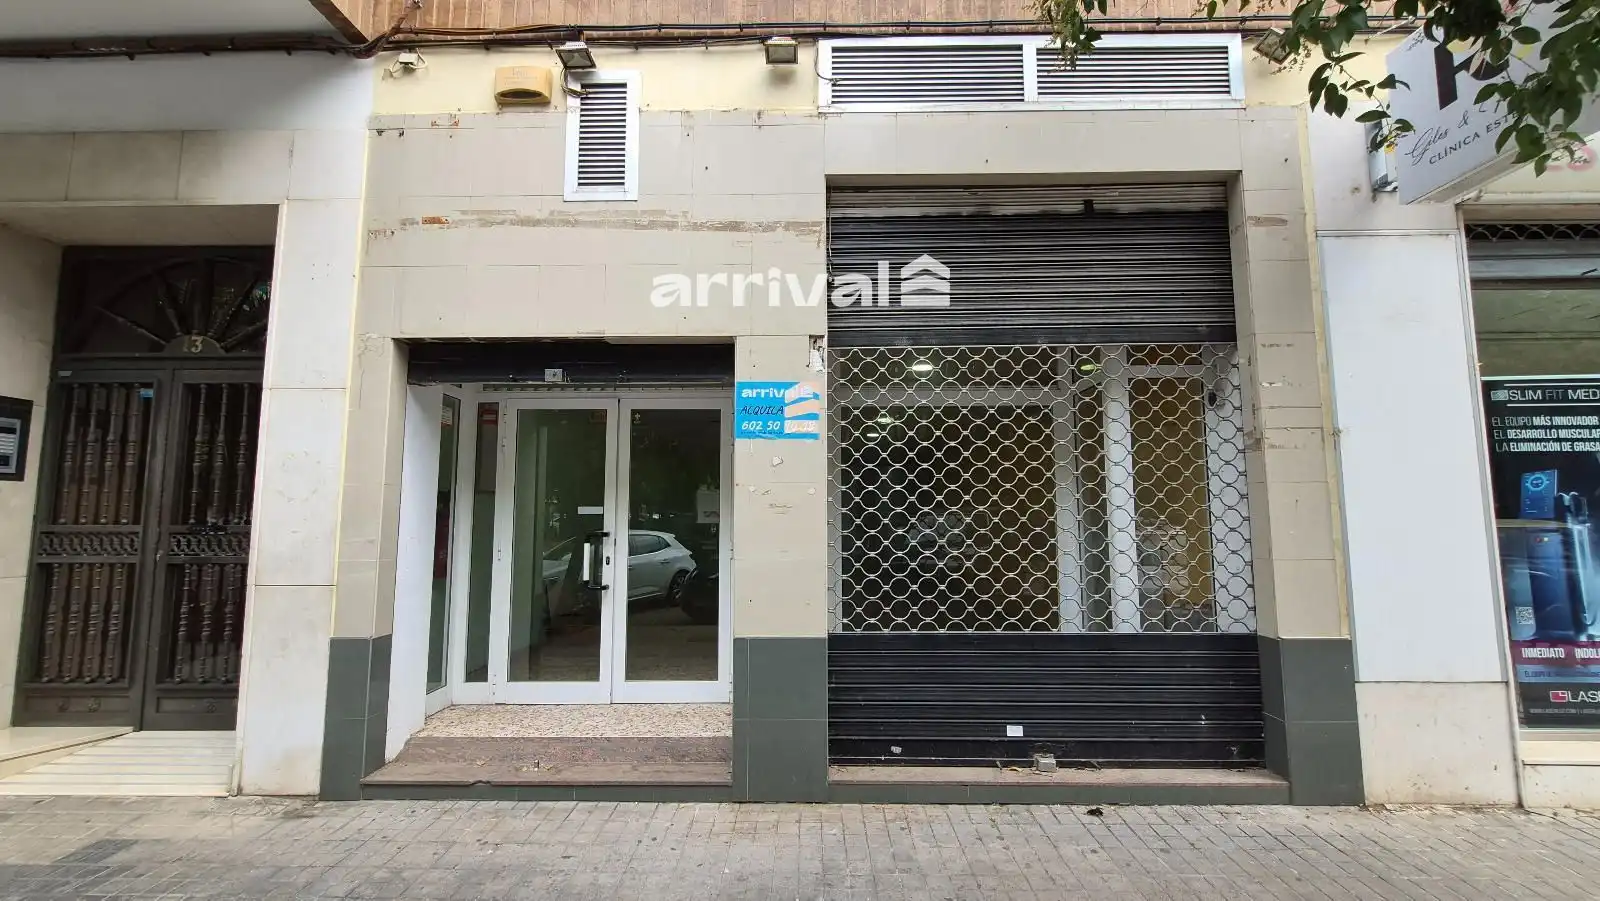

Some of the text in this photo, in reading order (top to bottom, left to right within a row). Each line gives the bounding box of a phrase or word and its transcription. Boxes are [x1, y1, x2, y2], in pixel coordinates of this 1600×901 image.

[1457, 110, 1469, 128] &
[741, 387, 803, 399] arrivl
[1509, 389, 1542, 401] SLIM
[1545, 389, 1564, 400] FIT
[741, 420, 763, 431] 602
[1492, 416, 1504, 427] EL
[1505, 416, 1531, 426] EQUIPO
[1532, 414, 1551, 426] MÁS
[1494, 429, 1505, 440] EL
[1507, 429, 1557, 439] DESARROLLO
[1496, 442, 1509, 452] LA
[1510, 440, 1561, 452] ELIMINACIÓN
[1561, 441, 1573, 452] DE
[1521, 647, 1600, 659] INMEDIATO INDOL
